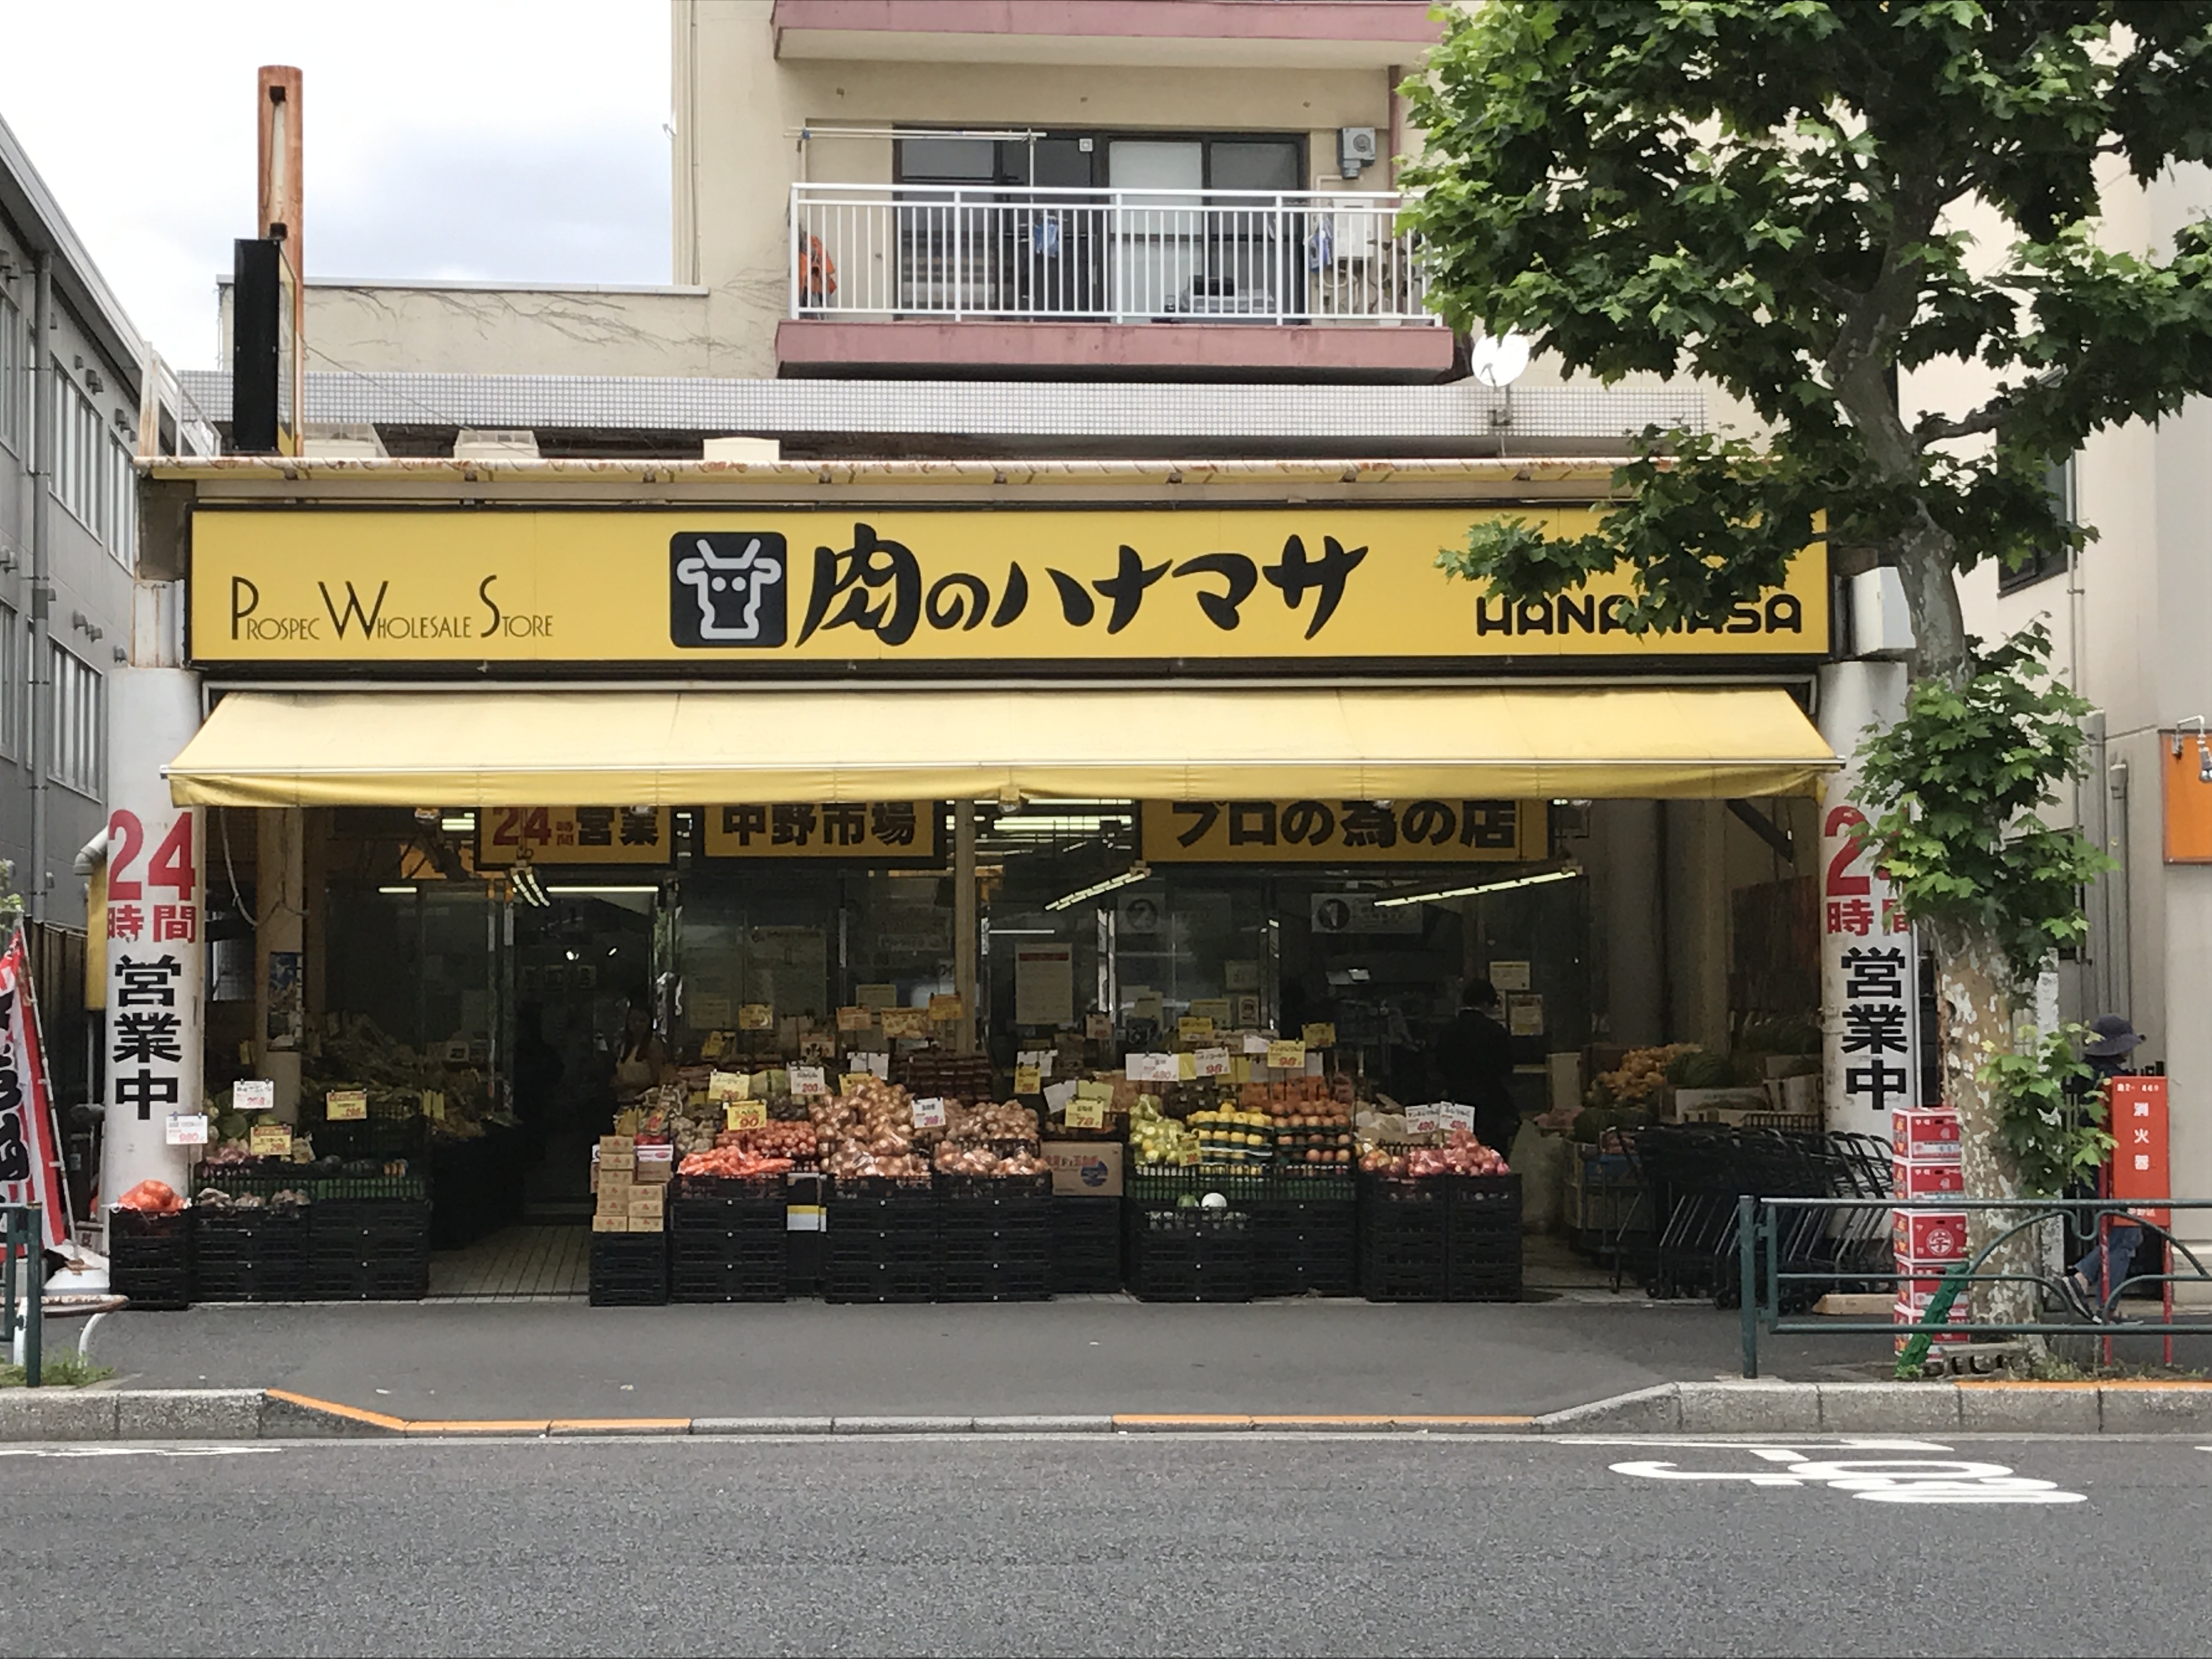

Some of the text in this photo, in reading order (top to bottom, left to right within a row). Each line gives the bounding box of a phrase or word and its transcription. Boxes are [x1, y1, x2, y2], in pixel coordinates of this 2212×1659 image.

[794, 522, 1369, 648] 肉のハナマサ
[1476, 594, 1802, 636] HANASA
[108, 809, 195, 901] 24
[723, 802, 916, 845] 中野市場
[1825, 805, 1908, 896] 2
[108, 905, 196, 943] 時間
[112, 955, 183, 1120] 営業中
[1841, 947, 1908, 1110] 営業中
[2133, 1102, 2149, 1171] 消火器
